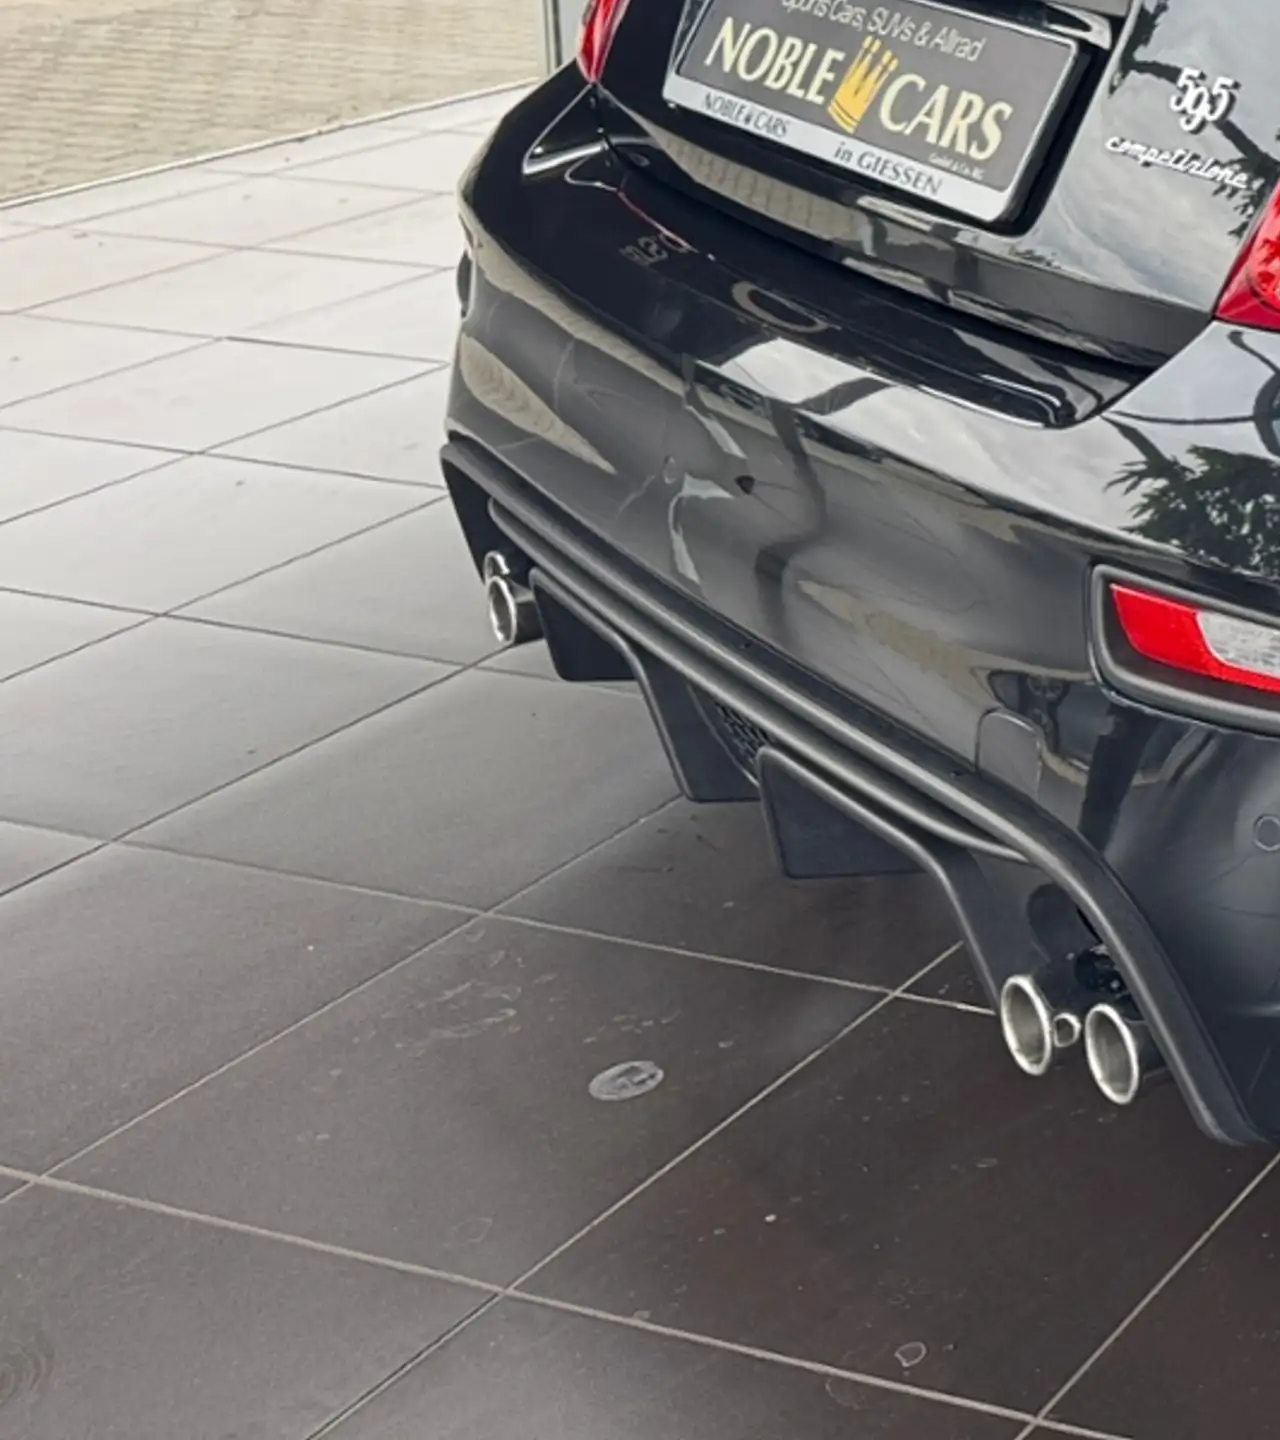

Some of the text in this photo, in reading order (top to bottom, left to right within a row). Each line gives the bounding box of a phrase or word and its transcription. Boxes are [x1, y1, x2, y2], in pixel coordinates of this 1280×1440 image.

[867, 7, 916, 42] SUVs
[913, 21, 933, 48] &
[929, 26, 987, 62] Allrad
[704, 16, 1014, 161] NOBLE CARS
[1169, 67, 1236, 132] 595
[833, 141, 854, 162] in
[856, 150, 944, 196] GIESSEN
